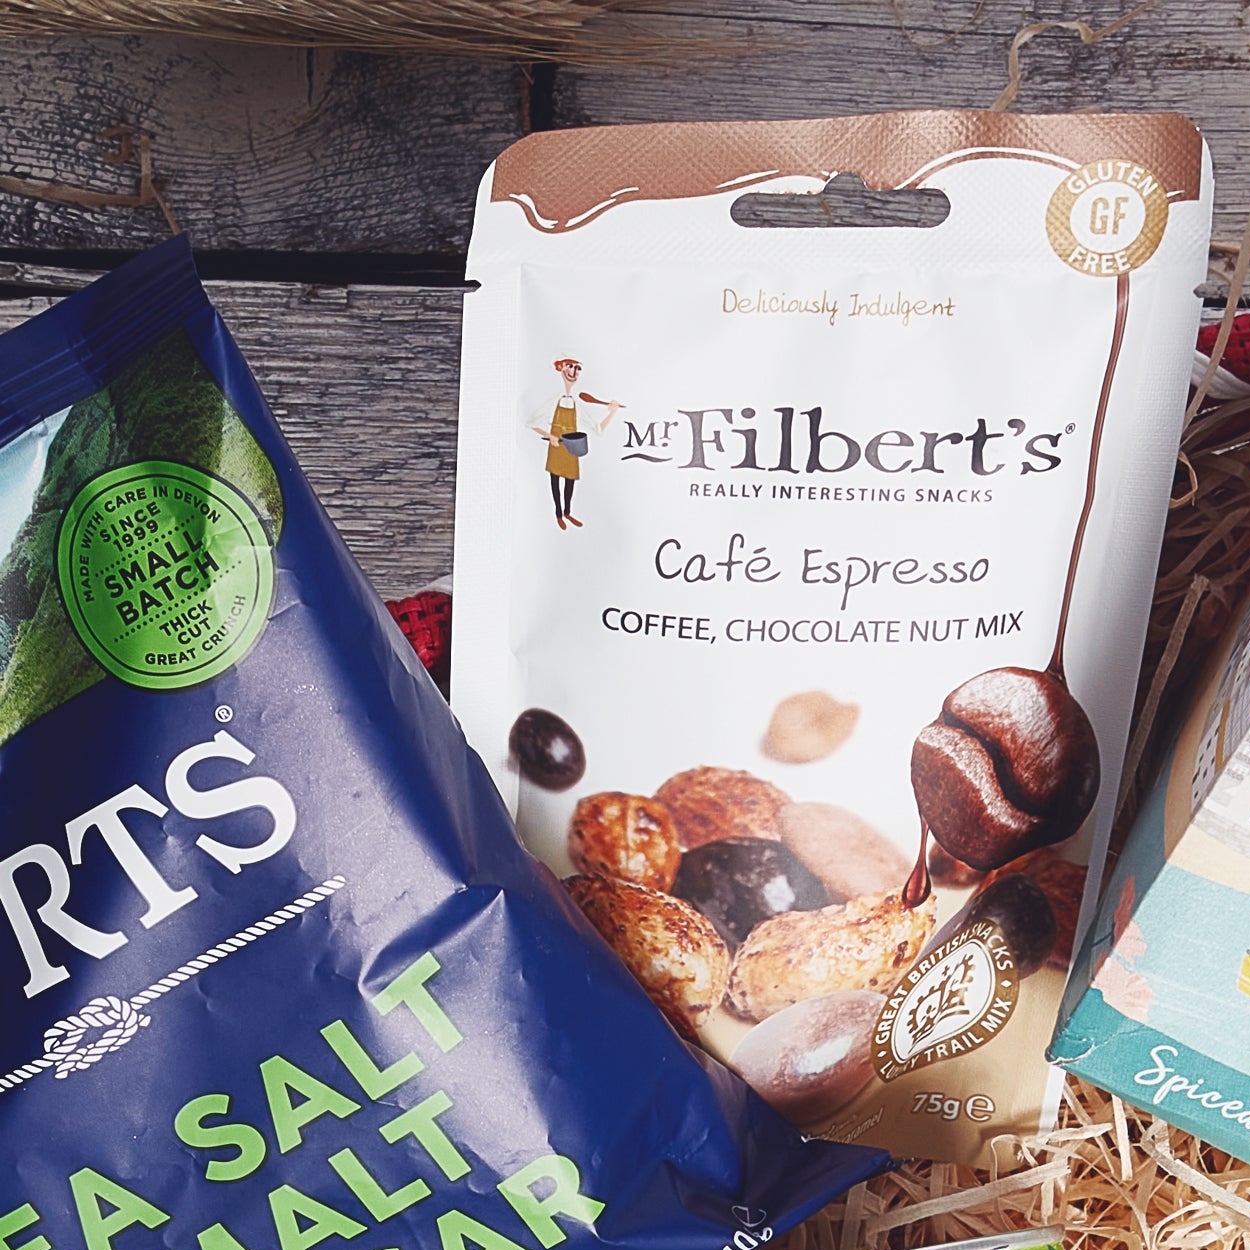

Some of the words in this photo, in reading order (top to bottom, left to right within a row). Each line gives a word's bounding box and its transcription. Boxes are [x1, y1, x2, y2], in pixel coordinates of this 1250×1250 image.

[1066, 161, 1159, 197] GLUTEN
[1090, 197, 1130, 235] GF
[1068, 246, 1131, 274] FREE
[722, 288, 839, 326] Deliciously
[848, 290, 955, 326] Indulgent
[620, 418, 679, 464] Mr
[104, 488, 147, 513] CARE
[153, 486, 168, 498] IN
[174, 489, 221, 524] DEVON
[689, 482, 764, 500] REALLY
[771, 484, 906, 502] INTERESTING
[914, 488, 994, 503] SNACKS
[81, 513, 105, 548] WITH
[100, 501, 161, 543] SINCE
[113, 520, 159, 551] 1999
[78, 555, 95, 603] MADE
[104, 530, 203, 599] SMALL
[654, 533, 782, 585] Café
[801, 548, 990, 611] Espresso
[116, 551, 220, 626] BATCH
[145, 647, 197, 666] GREAT
[202, 594, 246, 651] CRUNCH
[159, 600, 213, 637] THICK
[177, 618, 213, 645] CUT
[601, 607, 717, 645] COFFEE,
[725, 619, 900, 644] CHOCOLATE
[909, 618, 969, 643] NUT
[975, 610, 1024, 639] MIX
[875, 988, 908, 1044] GREAT
[908, 932, 973, 984] BRITISH
[970, 922, 1013, 971] SNACKS
[924, 1031, 984, 1062] TRAIL
[980, 997, 1013, 1033] MIX
[174, 951, 463, 1182] SALT
[912, 1094, 960, 1120] 75g
